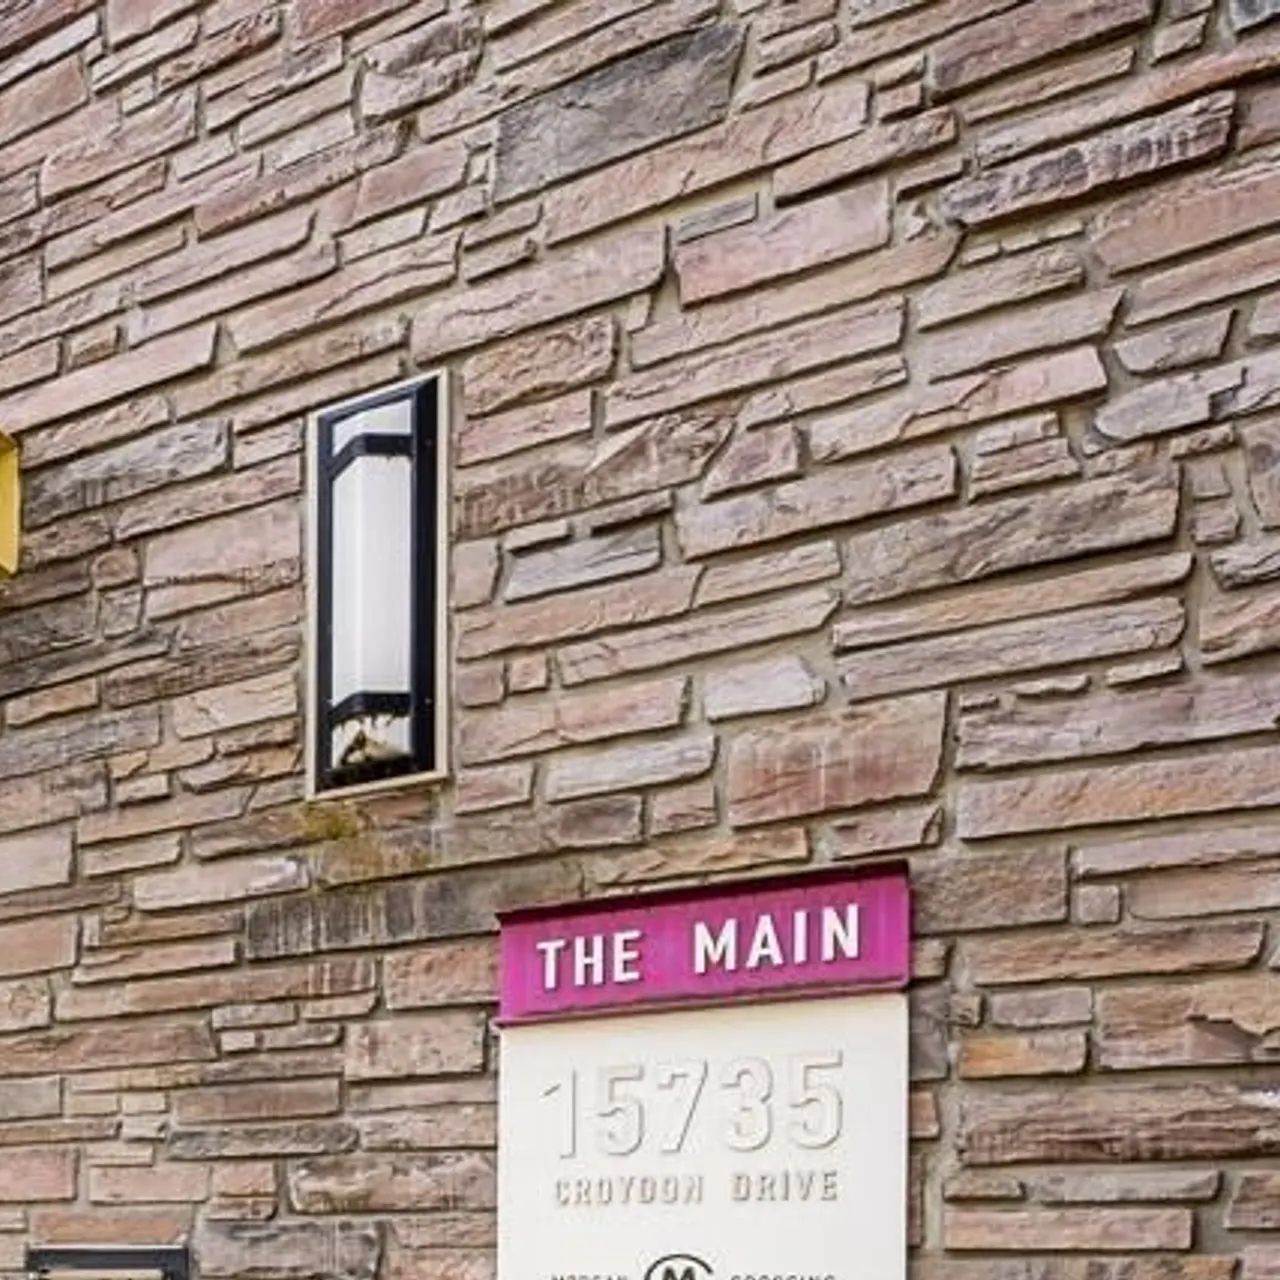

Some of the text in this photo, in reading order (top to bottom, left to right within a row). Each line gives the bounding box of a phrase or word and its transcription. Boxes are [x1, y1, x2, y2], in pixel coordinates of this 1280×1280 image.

[536, 903, 860, 990] THE MAIN
[540, 1049, 844, 1160] 15735
[554, 1169, 840, 1208] CROYDON DRIVE
